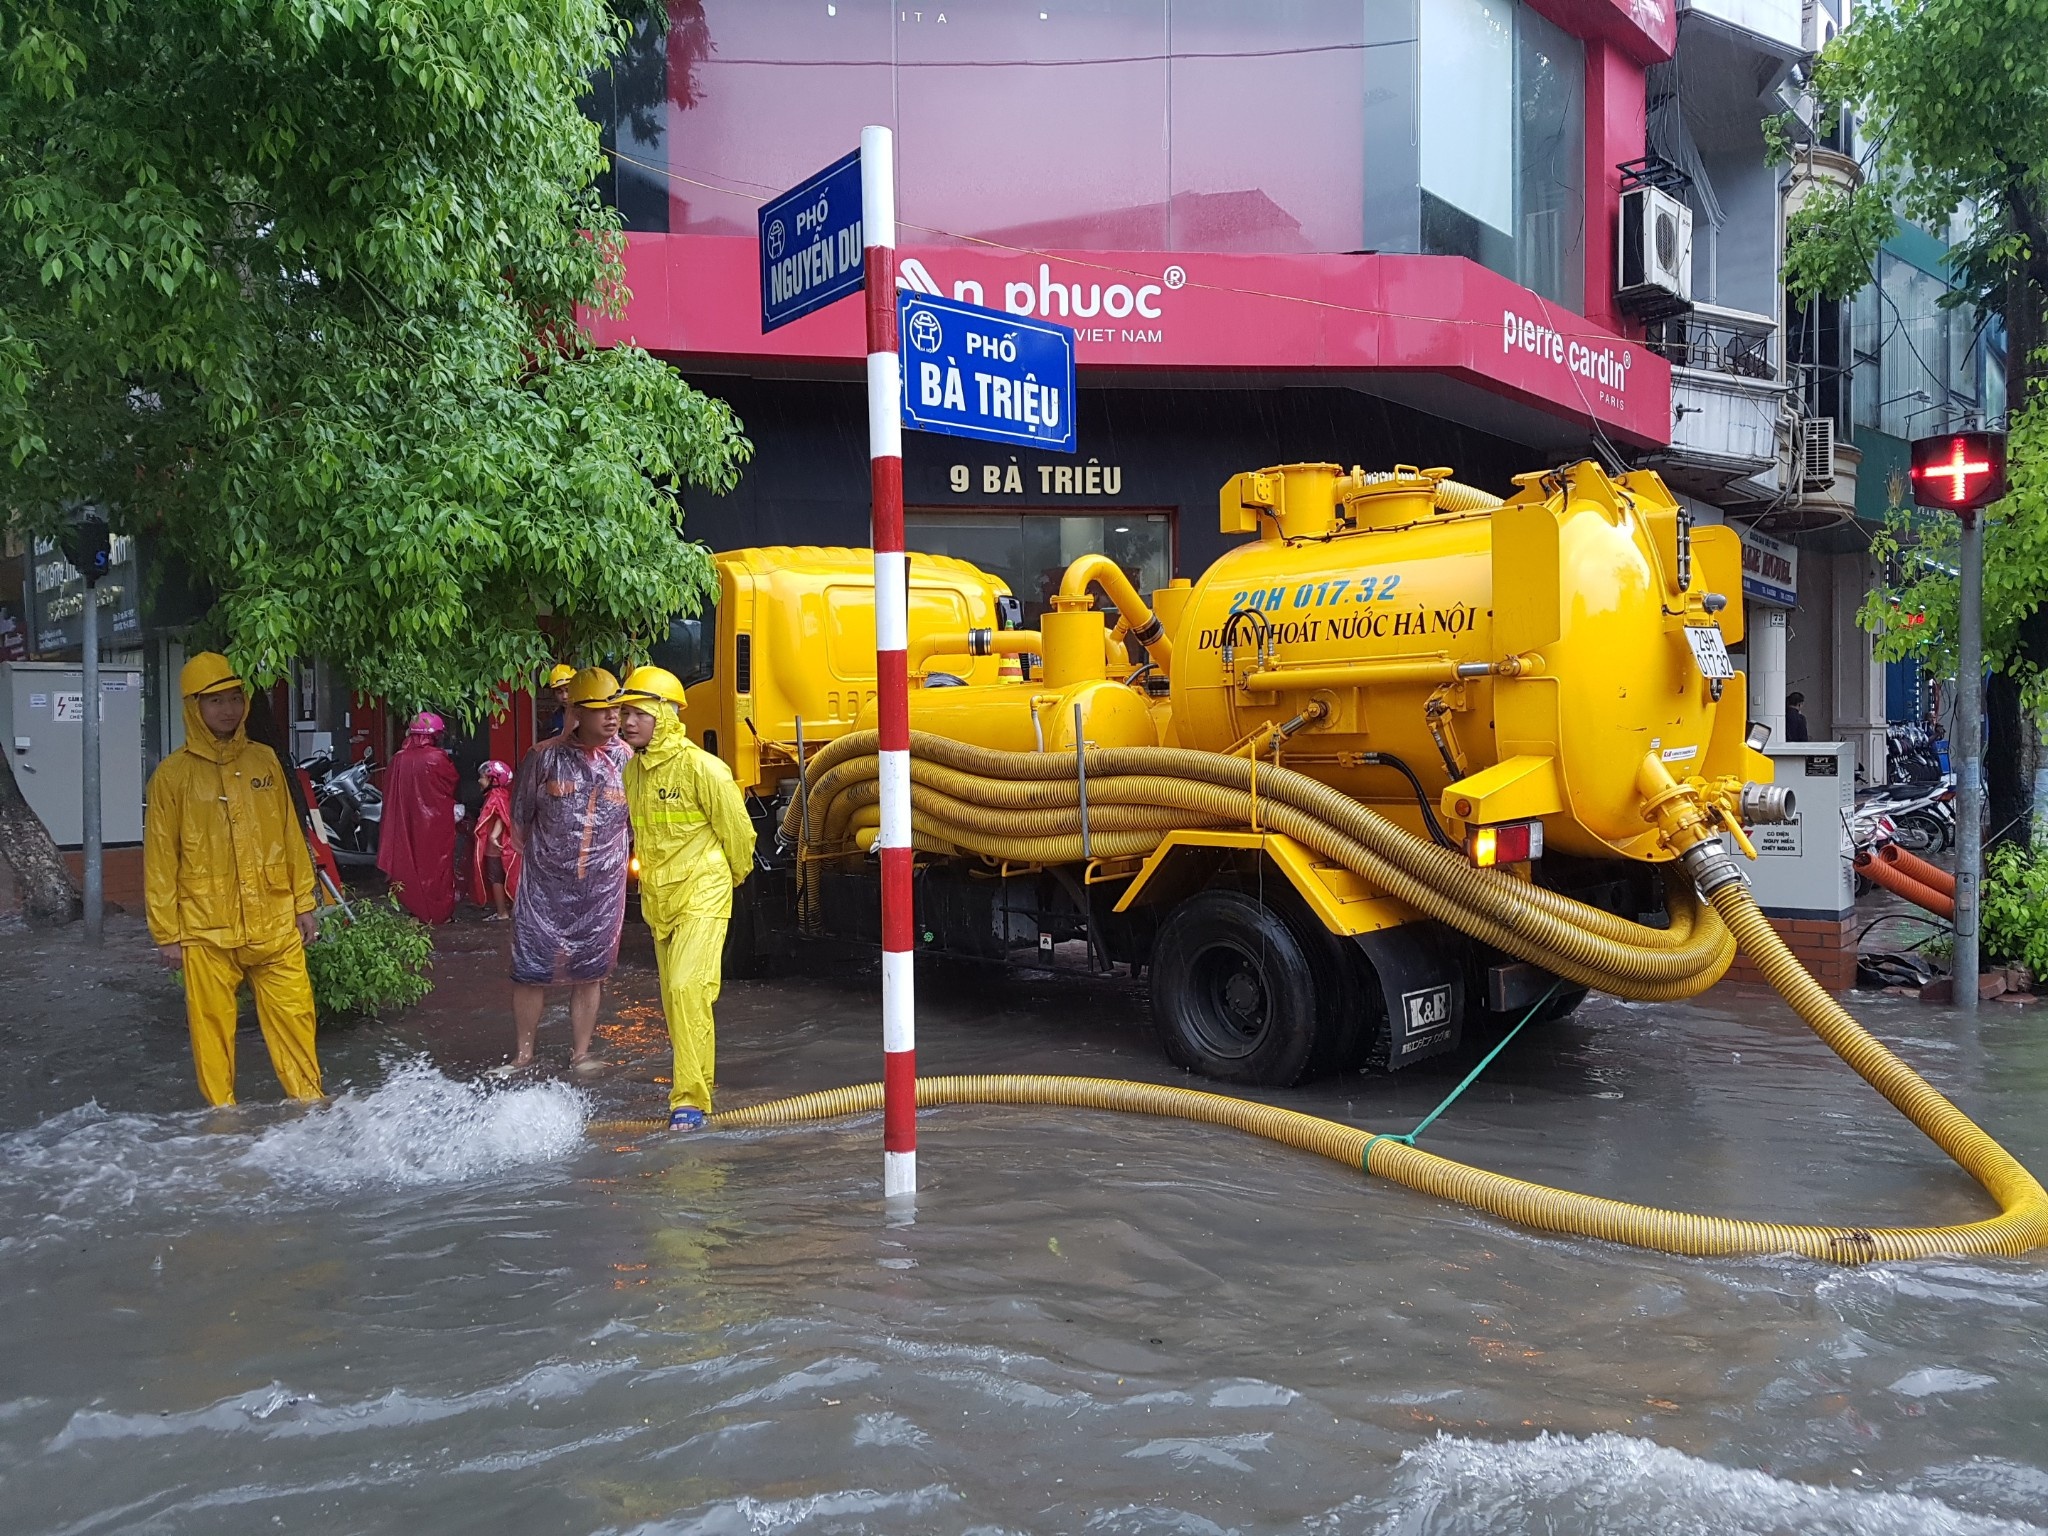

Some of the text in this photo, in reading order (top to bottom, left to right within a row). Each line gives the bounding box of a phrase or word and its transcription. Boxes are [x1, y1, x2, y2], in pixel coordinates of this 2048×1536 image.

[797, 187, 829, 236] PHỐ
[771, 220, 862, 306] NGUYỄN DU
[966, 331, 1018, 363] PHỐ
[1074, 328, 1163, 343] VIET NAM
[1503, 310, 1564, 364] pierre
[920, 356, 1060, 432] BÀ TRIỆU
[1599, 391, 1625, 411] PARIS
[949, 465, 970, 493] 9
[983, 455, 1024, 493] BÀ
[1229, 575, 1401, 615] 29H 017.32
[1258, 613, 1322, 648] THOÁT
[1326, 606, 1389, 641] NƯỚC
[1393, 603, 1426, 636] HÀ
[1431, 601, 1478, 639] NỘI
[1774, 614, 1784, 622] 73
[1694, 630, 1718, 651] 29H
